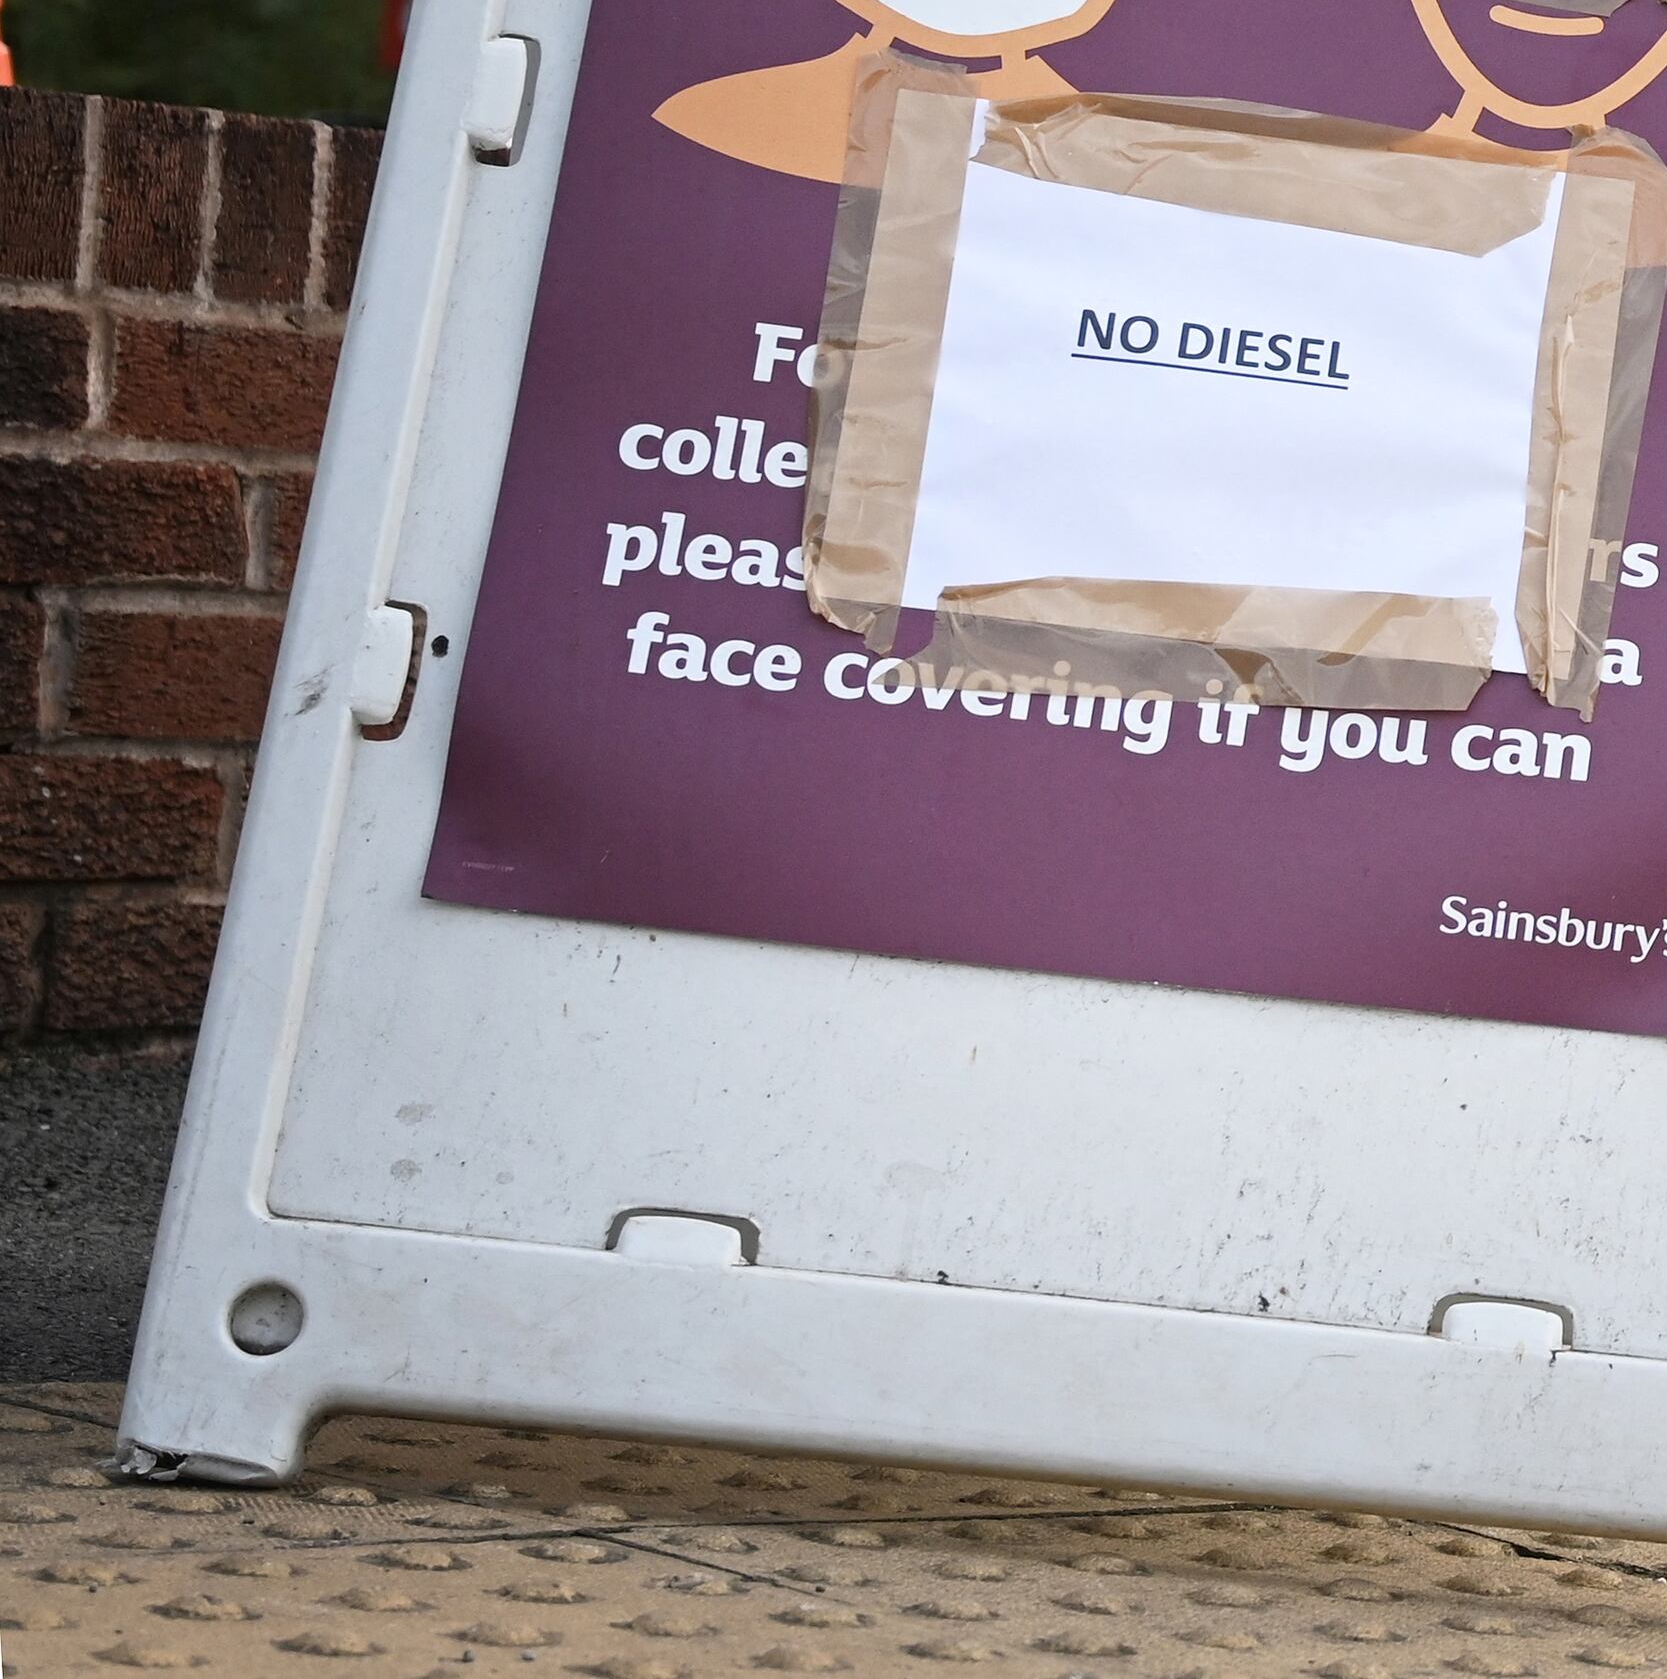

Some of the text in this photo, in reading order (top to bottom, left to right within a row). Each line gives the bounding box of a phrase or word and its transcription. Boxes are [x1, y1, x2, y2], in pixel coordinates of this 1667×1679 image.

[1077, 308, 1350, 380] NO DIESEL
[617, 415, 809, 489] colle
[601, 511, 1644, 687] pleas a
[626, 610, 1594, 782] face covering if you can
